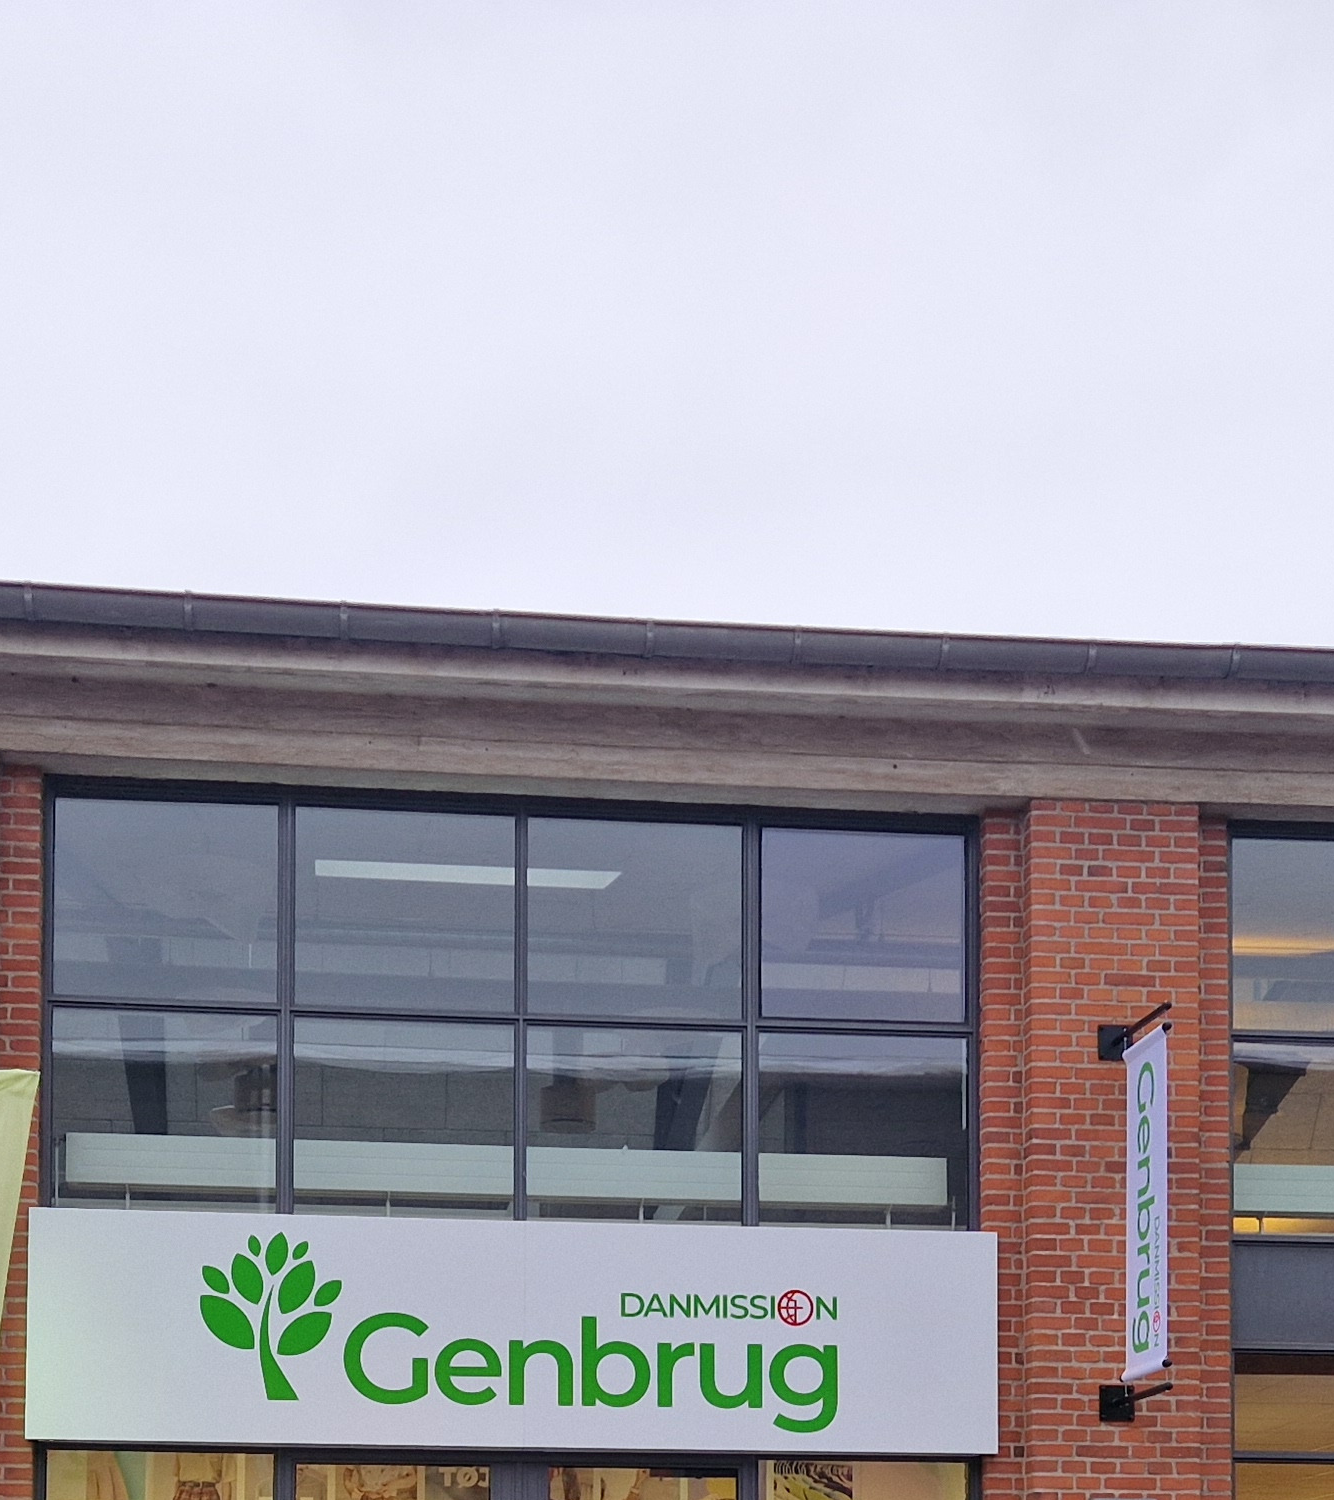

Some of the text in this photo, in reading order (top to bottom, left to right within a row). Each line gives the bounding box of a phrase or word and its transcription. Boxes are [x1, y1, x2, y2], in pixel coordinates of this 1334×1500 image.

[1132, 1061, 1157, 1354] Genbrug
[620, 1288, 838, 1327] DANMISSION
[1153, 1215, 1161, 1348] DANMISSION
[342, 1310, 839, 1434] Genbrug
